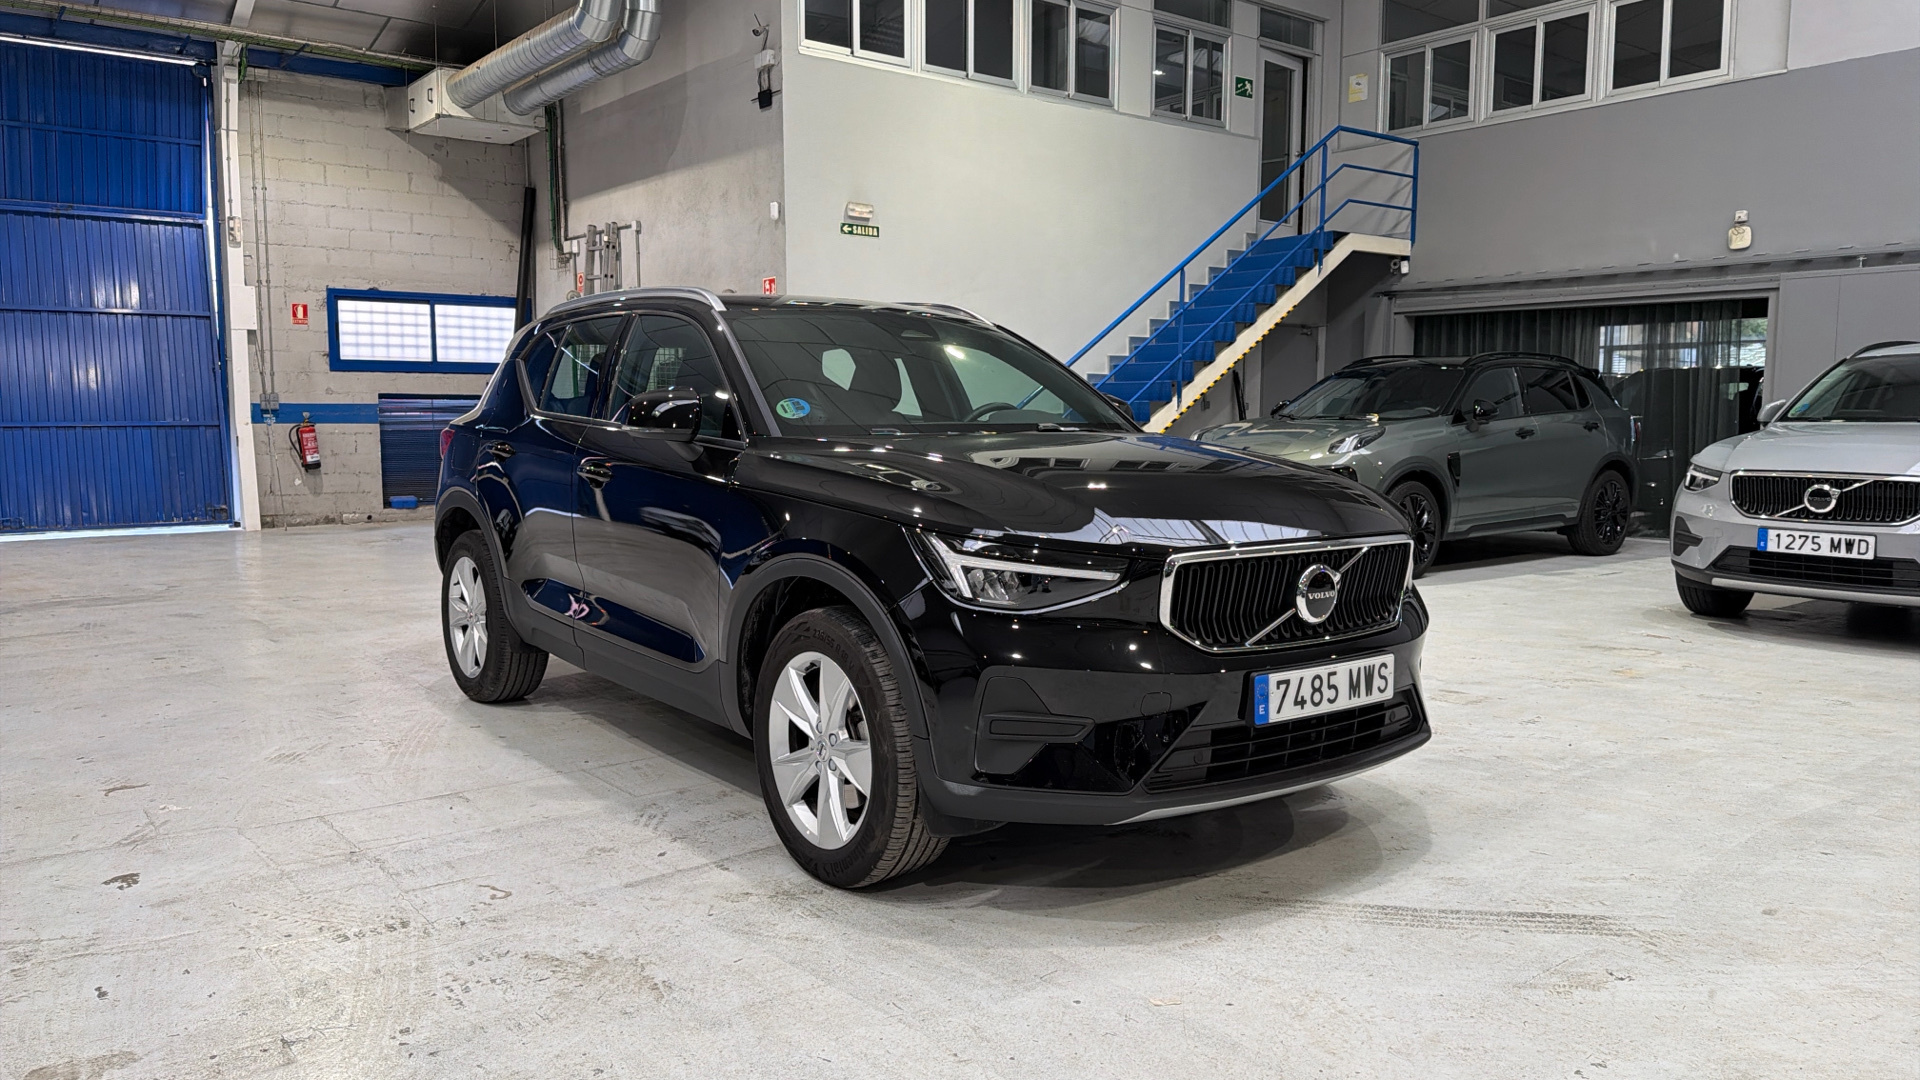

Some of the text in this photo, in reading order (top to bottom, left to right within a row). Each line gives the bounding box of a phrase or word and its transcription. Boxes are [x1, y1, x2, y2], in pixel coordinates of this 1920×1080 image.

[853, 225, 878, 236] SALIDA
[1775, 533, 1870, 556] 1275 MWD
[1308, 590, 1335, 600] VOLVO
[1276, 662, 1389, 714] 7485 MWS
[1259, 704, 1265, 715] E
